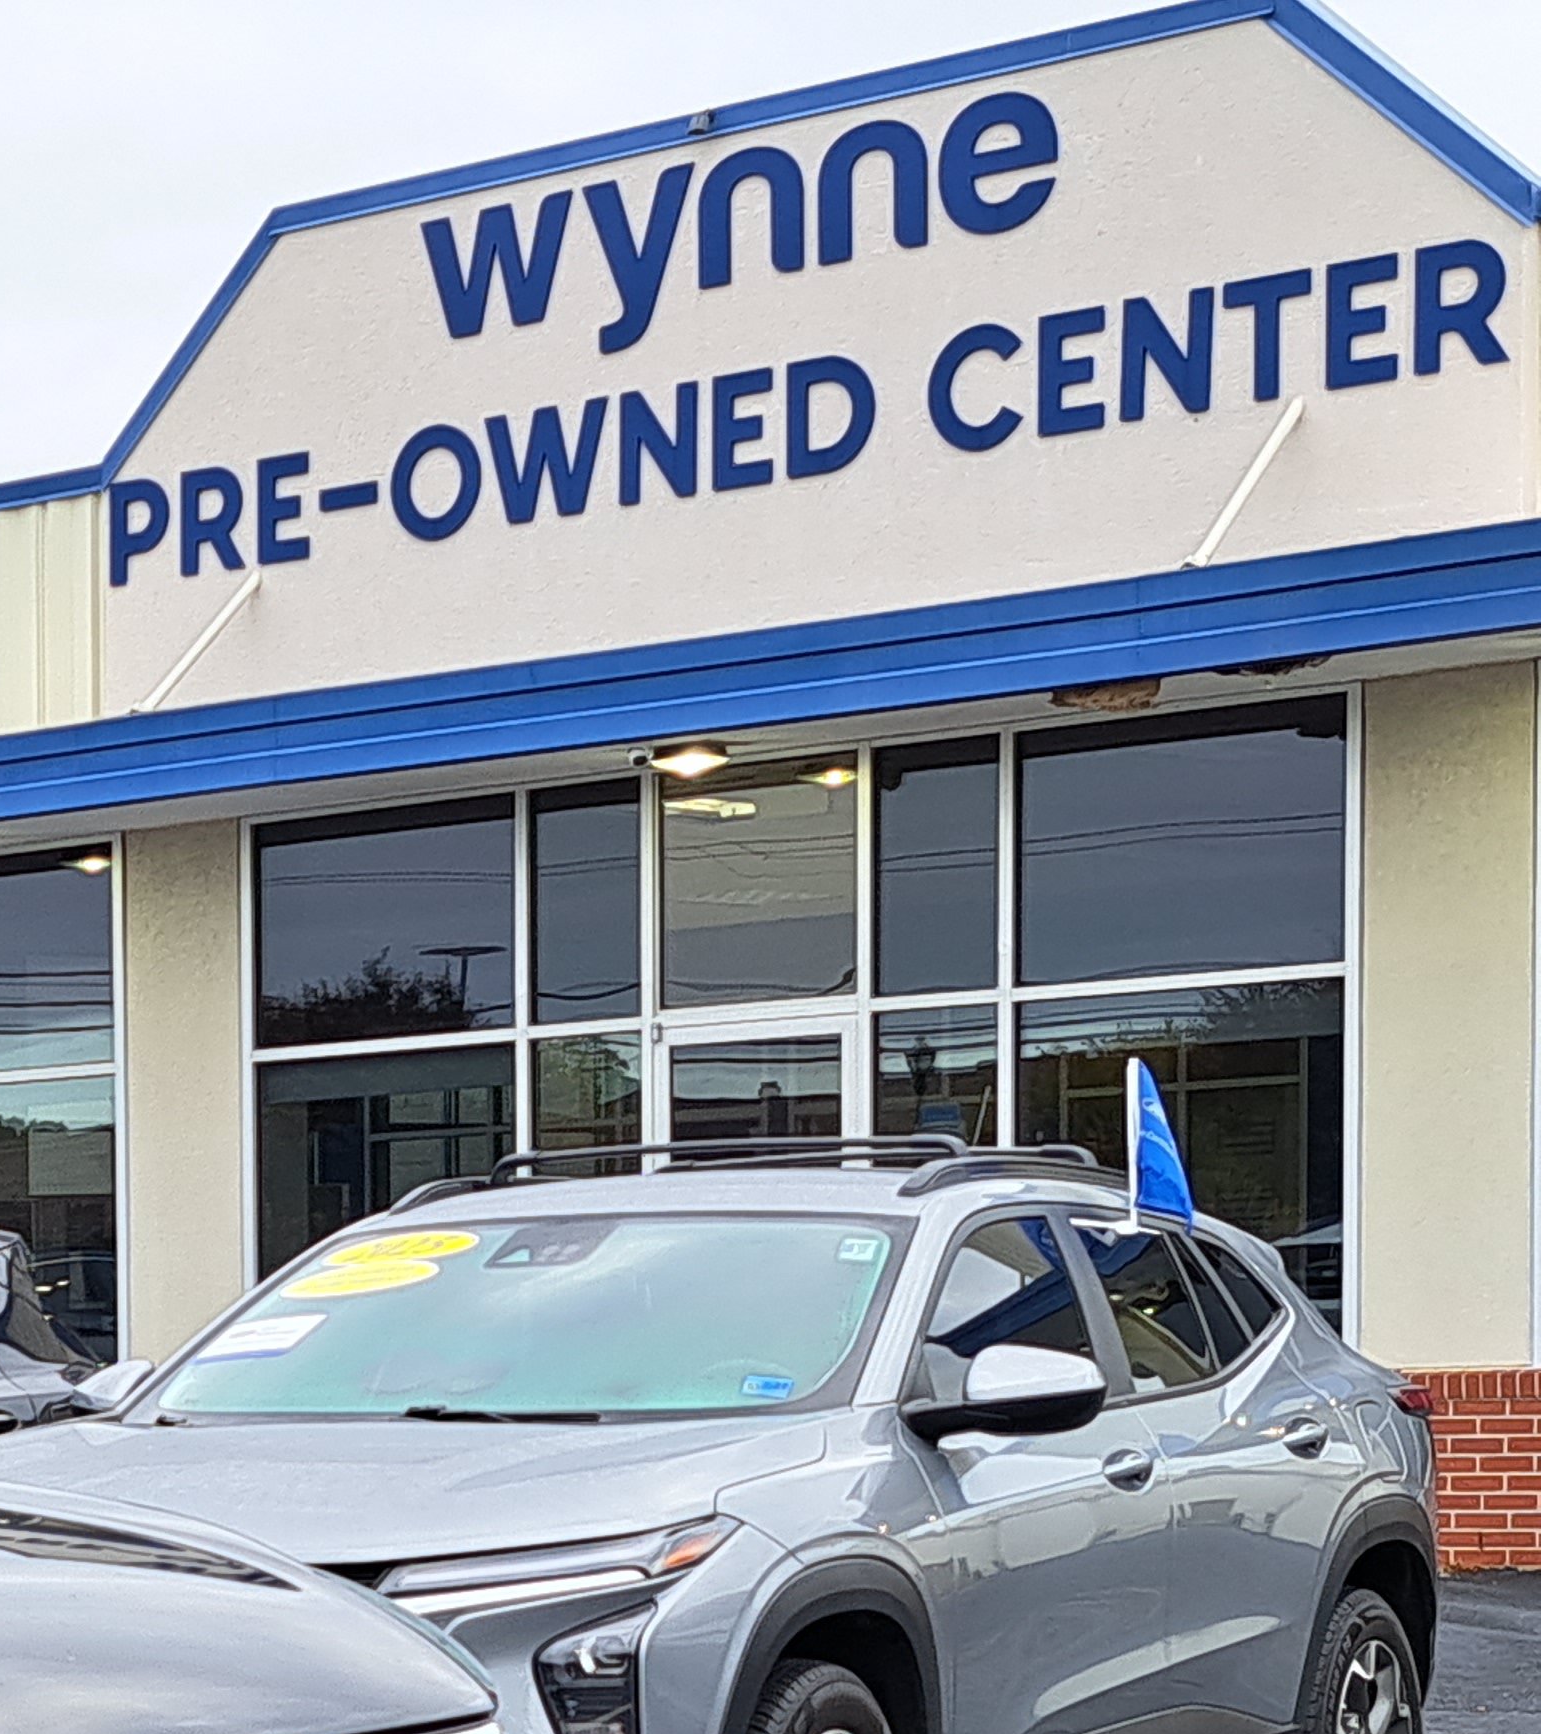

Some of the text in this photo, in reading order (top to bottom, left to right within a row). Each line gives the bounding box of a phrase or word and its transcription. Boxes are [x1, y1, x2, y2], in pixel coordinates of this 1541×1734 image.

[419, 90, 1060, 356] wynne
[108, 238, 1509, 587] PRE-OWNED CENTER
